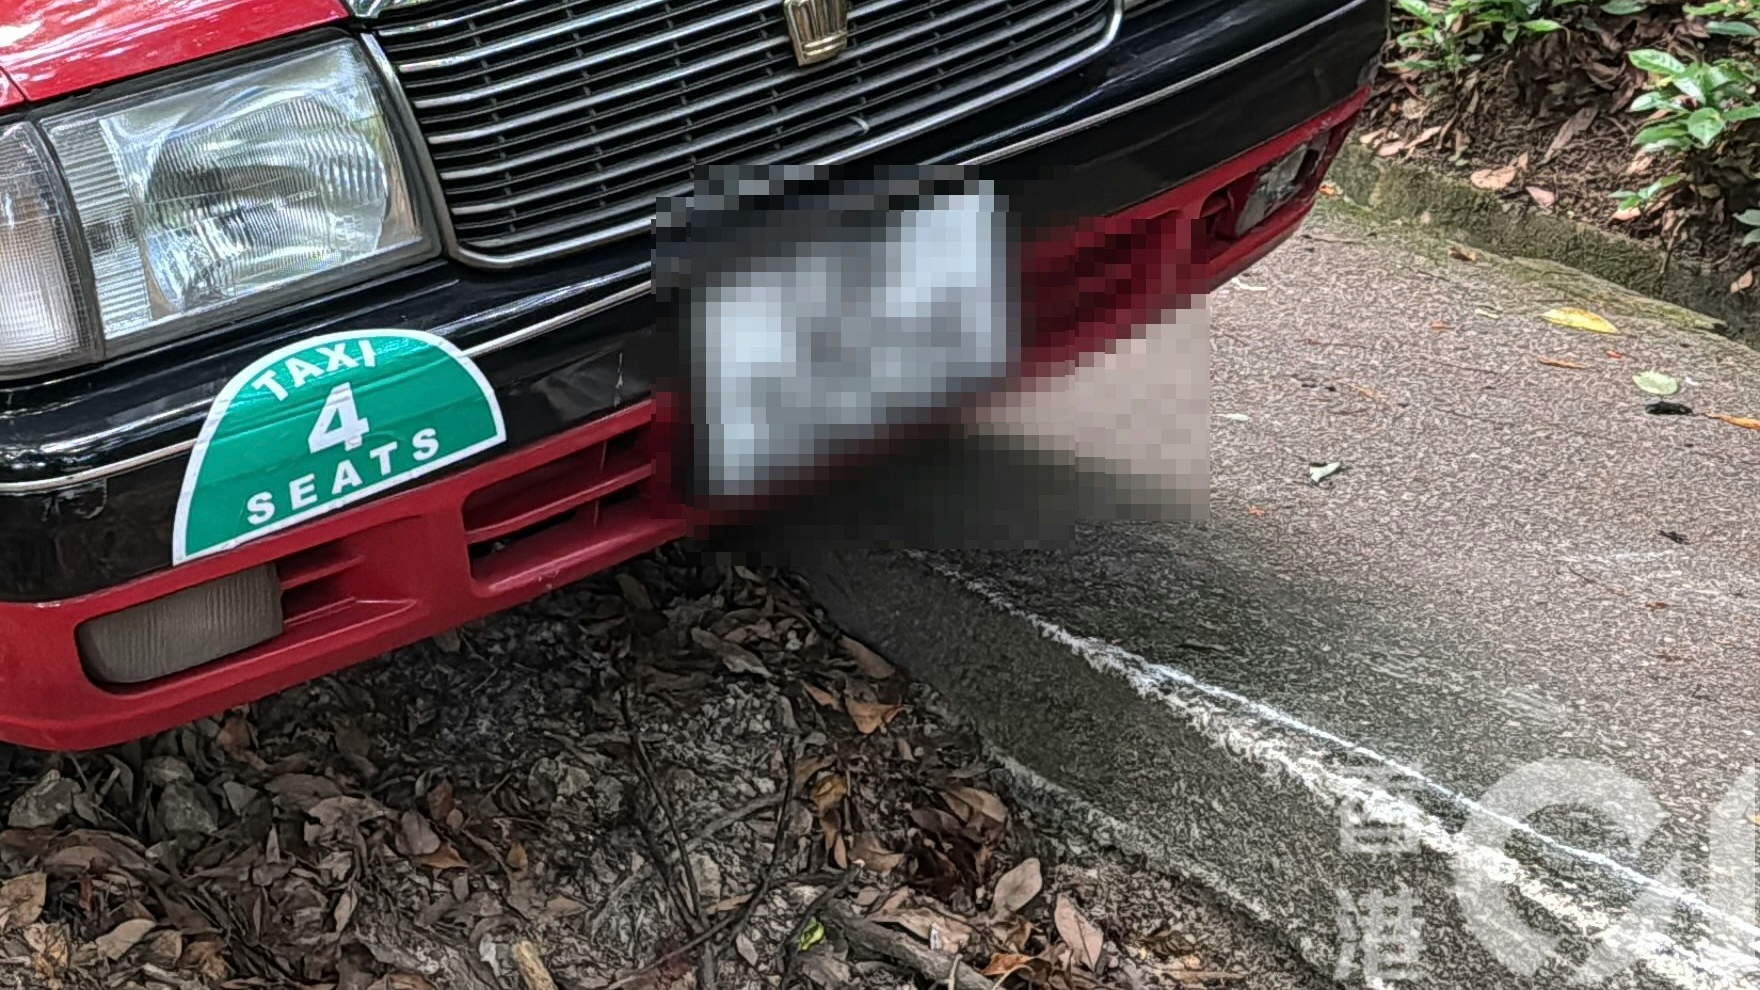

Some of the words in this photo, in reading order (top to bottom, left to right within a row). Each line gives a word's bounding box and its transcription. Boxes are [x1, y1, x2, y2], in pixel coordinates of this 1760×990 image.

[251, 339, 376, 402] TAXI
[307, 382, 370, 454] 4
[246, 428, 440, 526] SEATS
